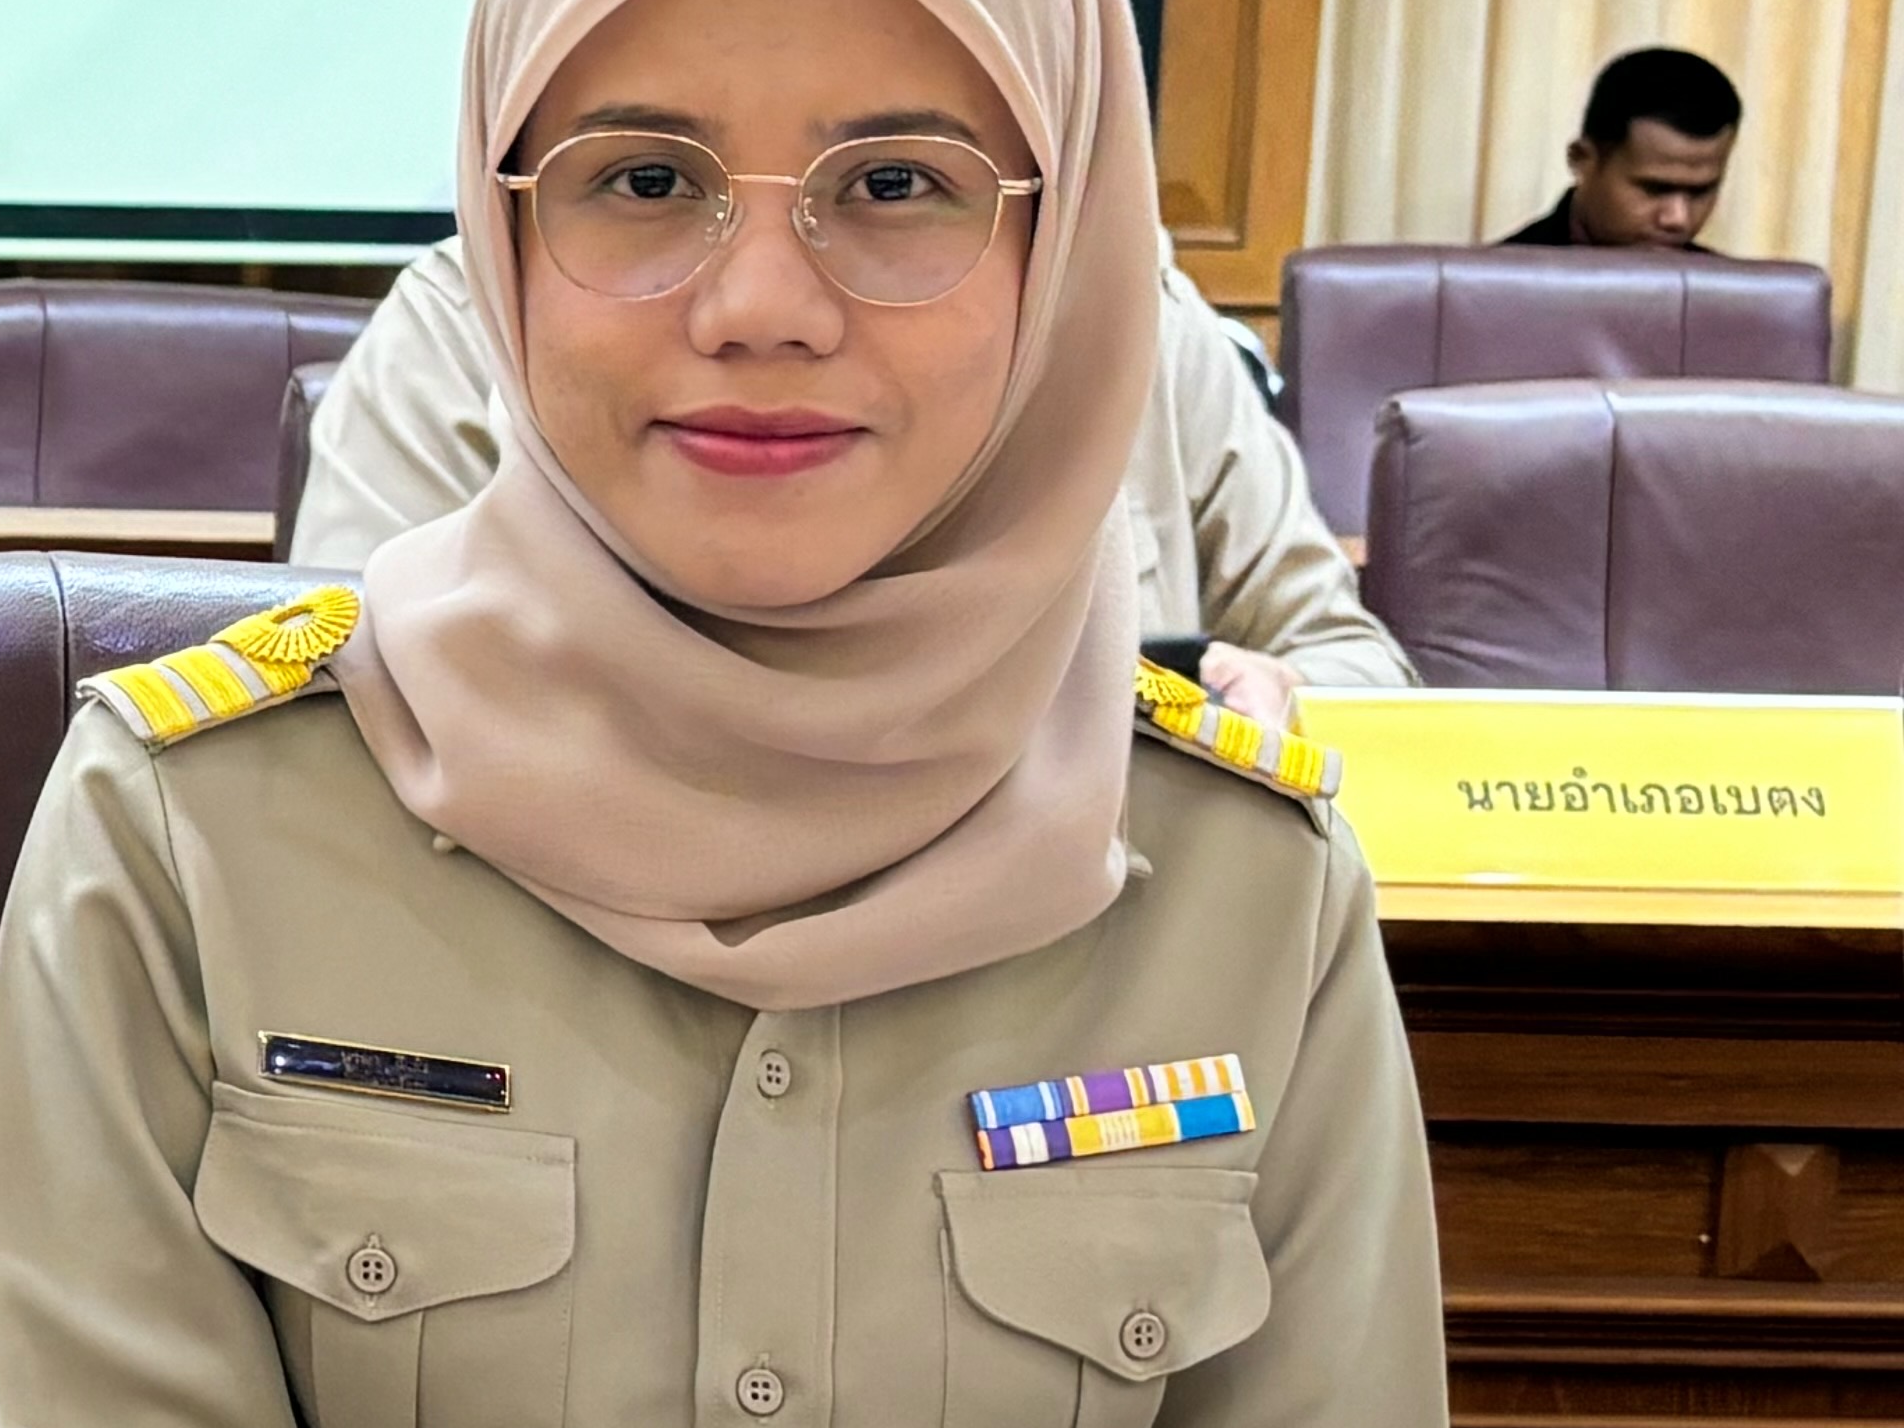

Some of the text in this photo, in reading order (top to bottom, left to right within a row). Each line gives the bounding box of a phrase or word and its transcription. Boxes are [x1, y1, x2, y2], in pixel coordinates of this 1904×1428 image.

[1457, 766, 1826, 818] นายอำเภอเบตง
